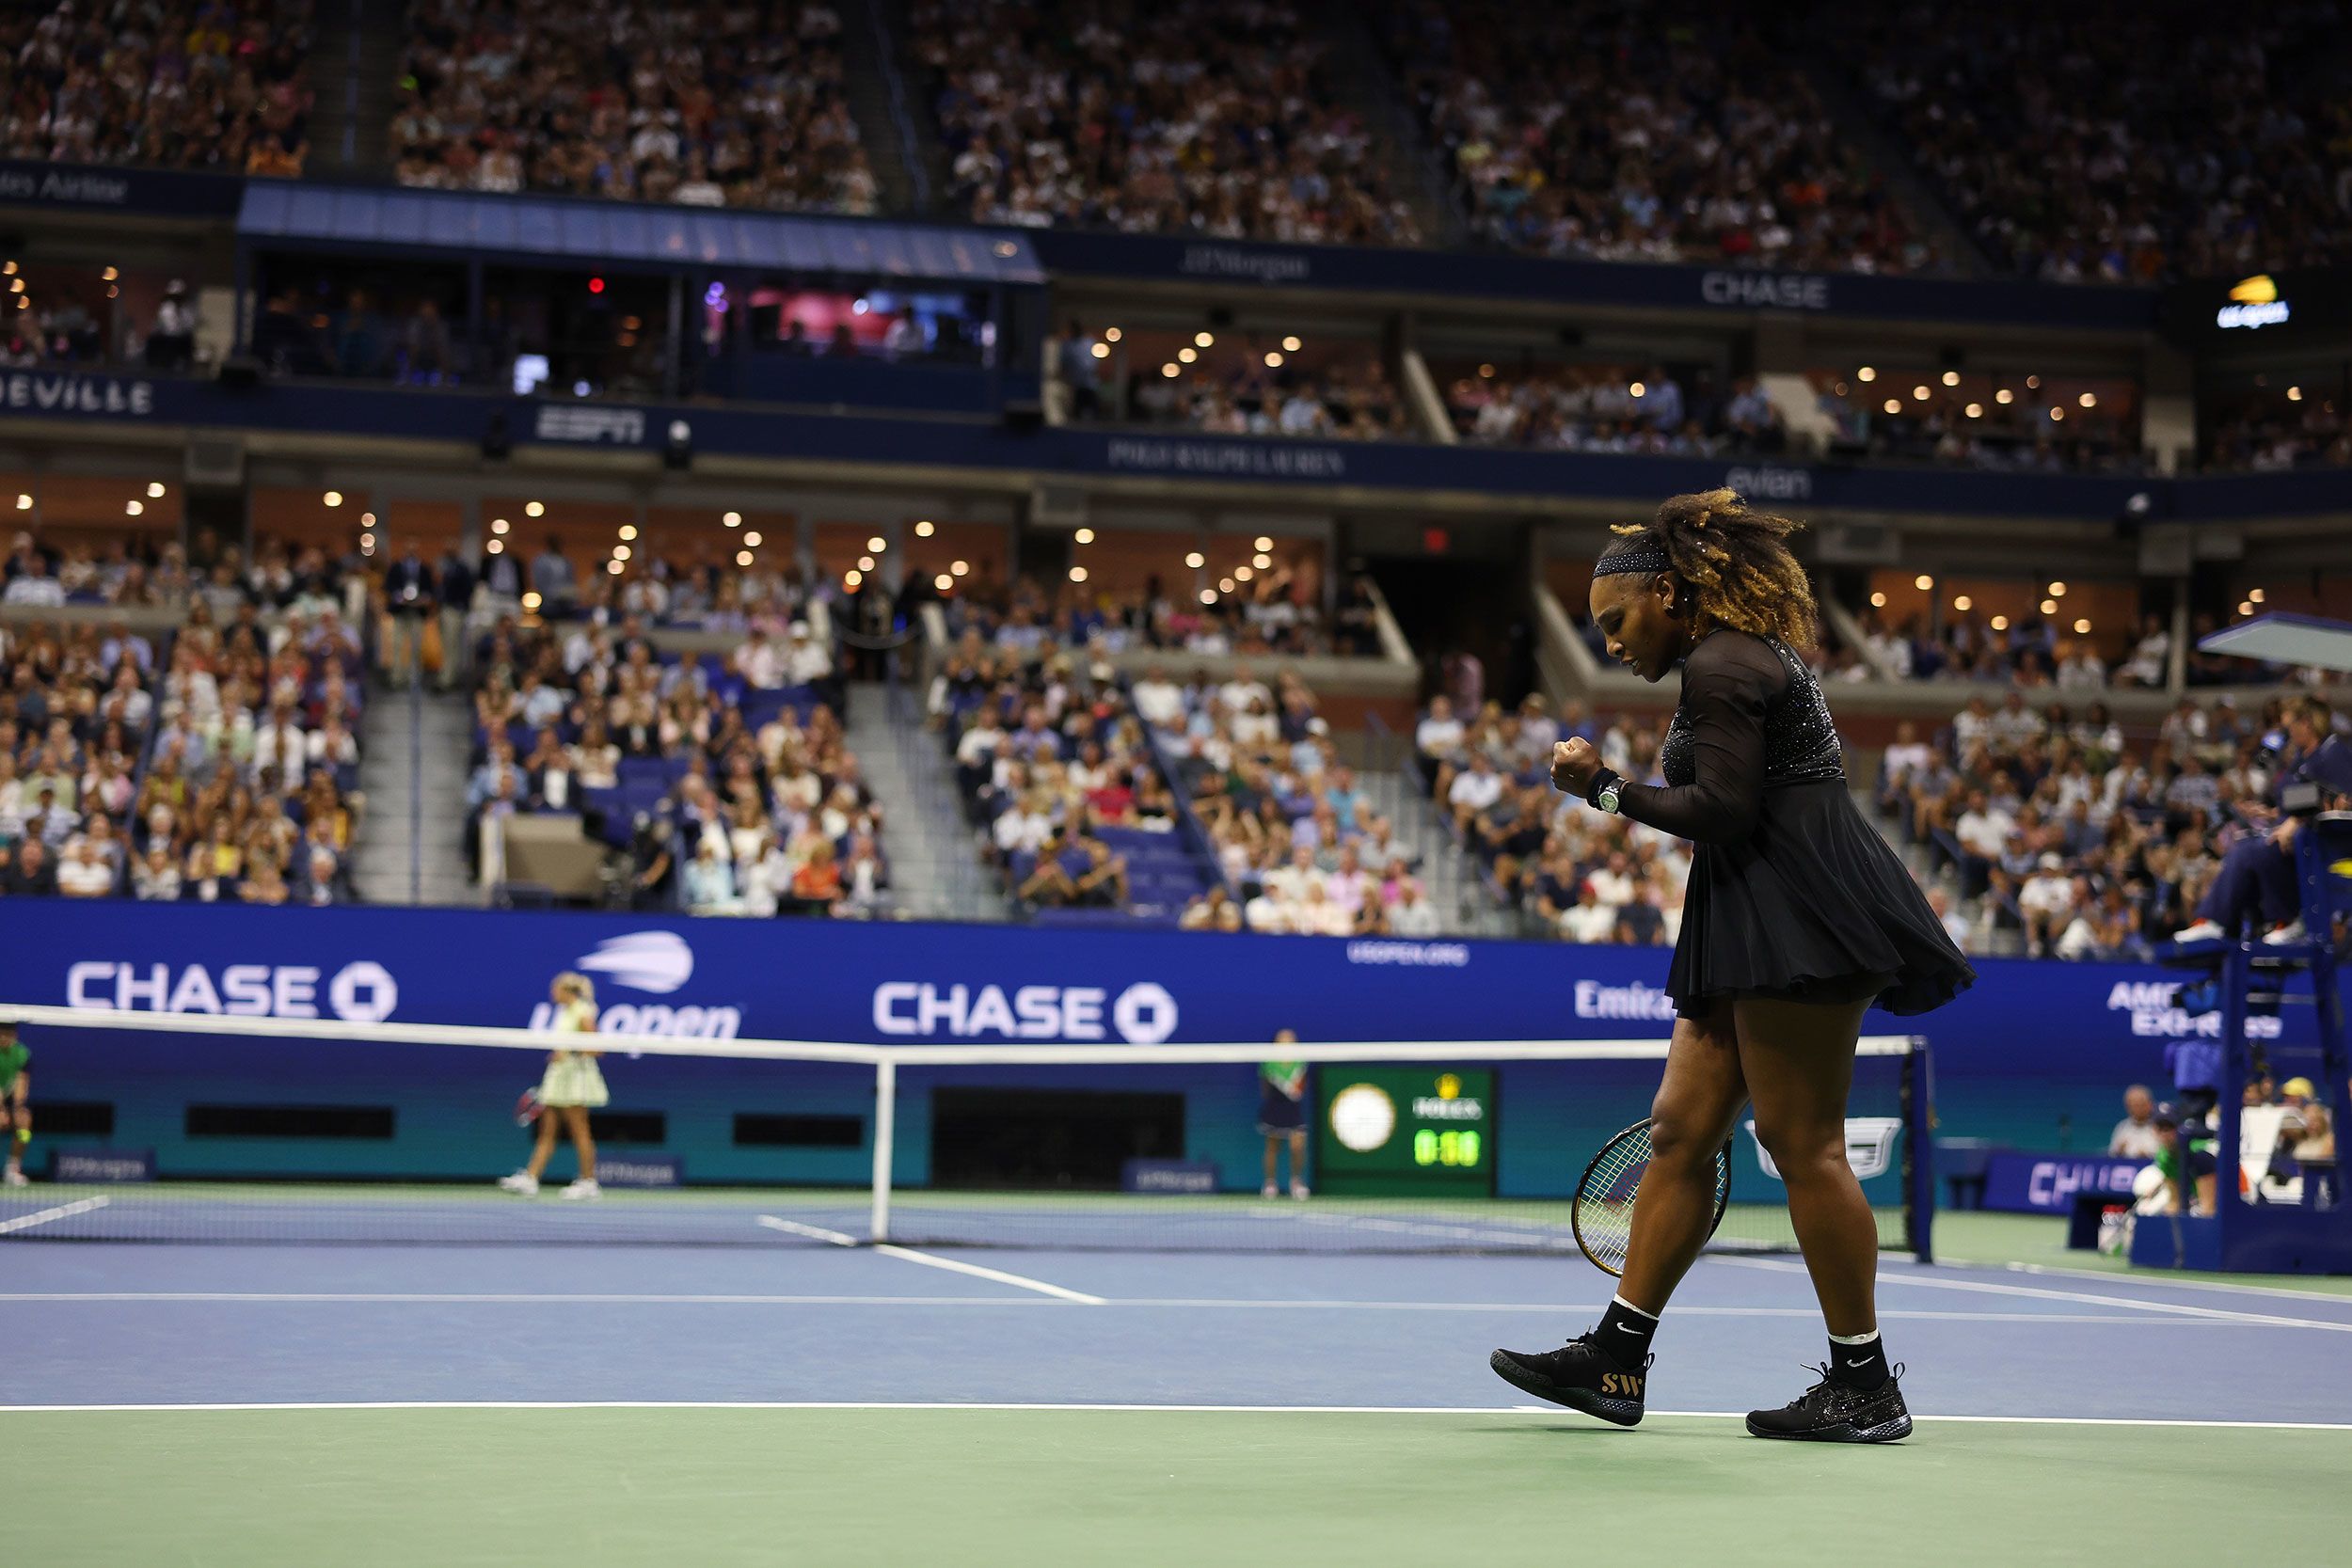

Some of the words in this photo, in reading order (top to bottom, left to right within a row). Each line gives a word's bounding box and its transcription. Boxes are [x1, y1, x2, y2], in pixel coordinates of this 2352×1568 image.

[1702, 271, 1828, 309] CHASE
[536, 404, 645, 444] ESPN
[1725, 465, 1812, 499] evian
[67, 961, 322, 1019] CHASE
[1574, 979, 1677, 1021] Emira
[872, 981, 1107, 1040] CHASE
[2132, 1007, 2283, 1038] EXPRSS
[1601, 1372, 1643, 1397] SW
